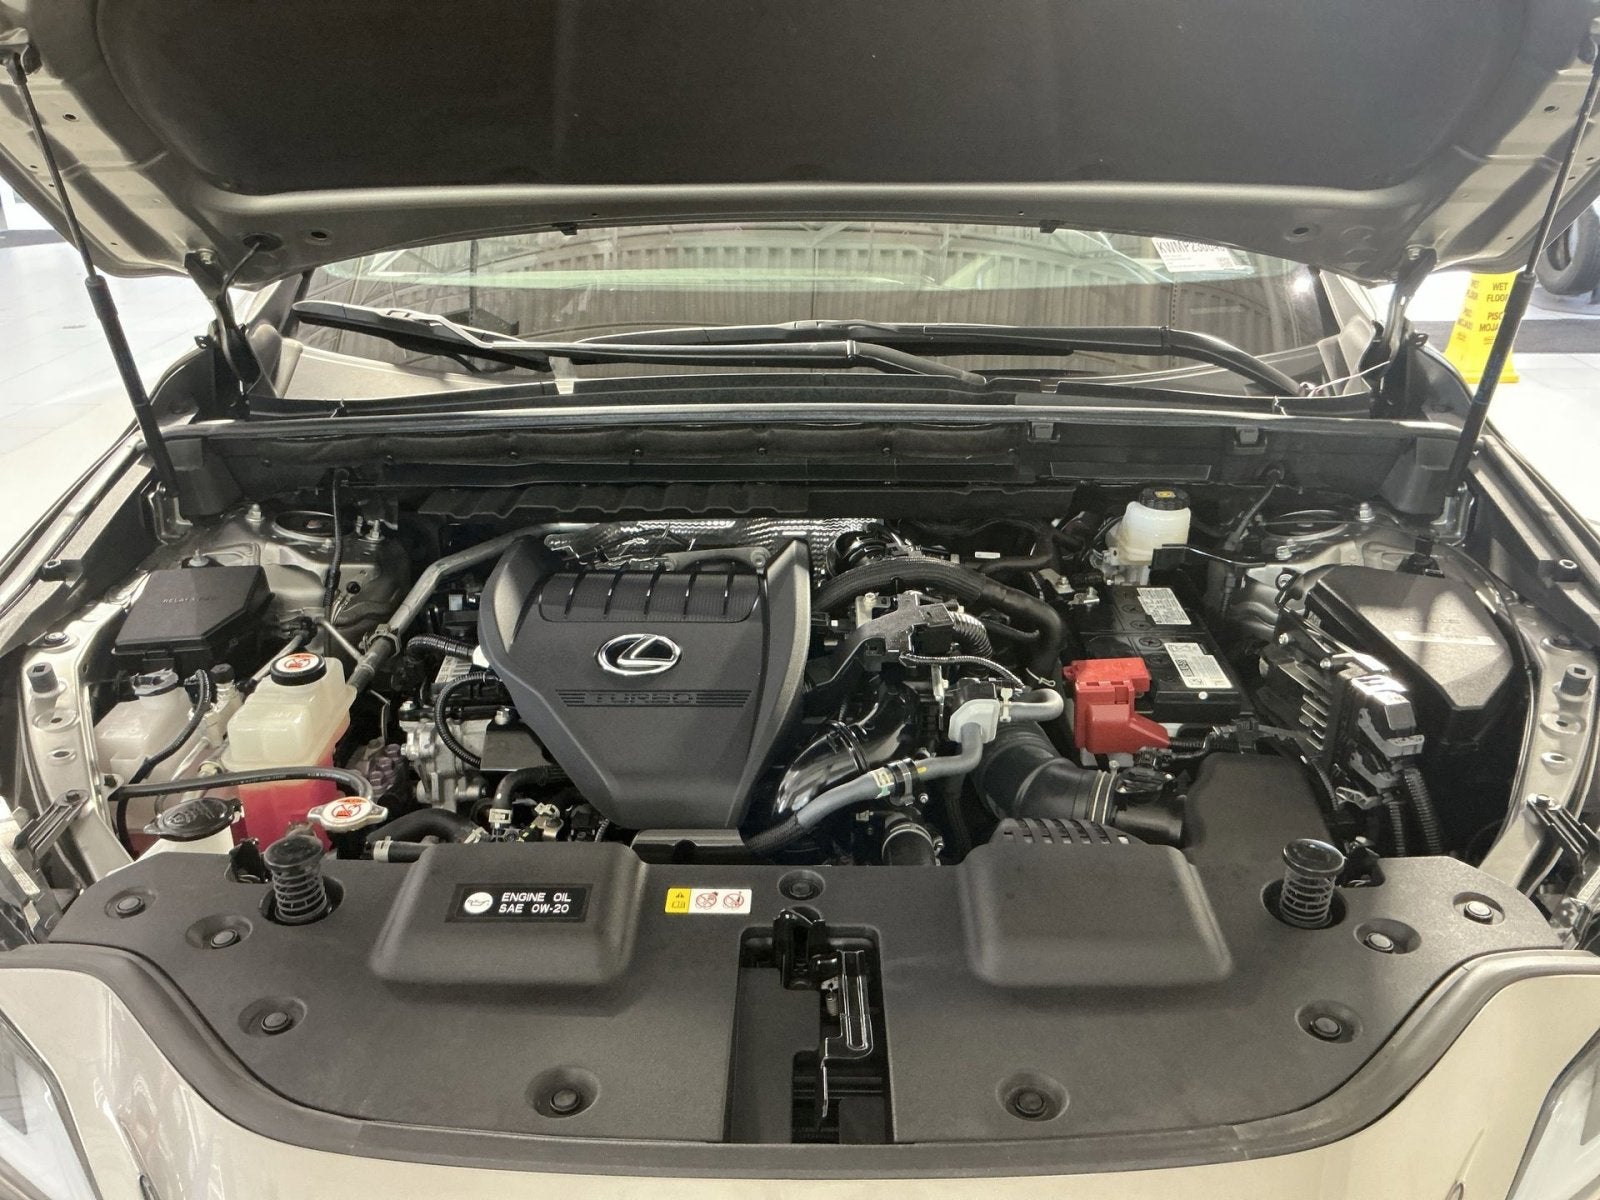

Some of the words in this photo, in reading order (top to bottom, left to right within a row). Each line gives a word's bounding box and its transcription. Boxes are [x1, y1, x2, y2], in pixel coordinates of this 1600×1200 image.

[1492, 282, 1508, 291] WET
[1479, 323, 1499, 332] MOJA
[584, 692, 697, 705] TURBO
[501, 892, 546, 902] ENGINE
[553, 892, 572, 902] OIL
[499, 904, 523, 913] SAE
[531, 904, 570, 913] 0W-20
